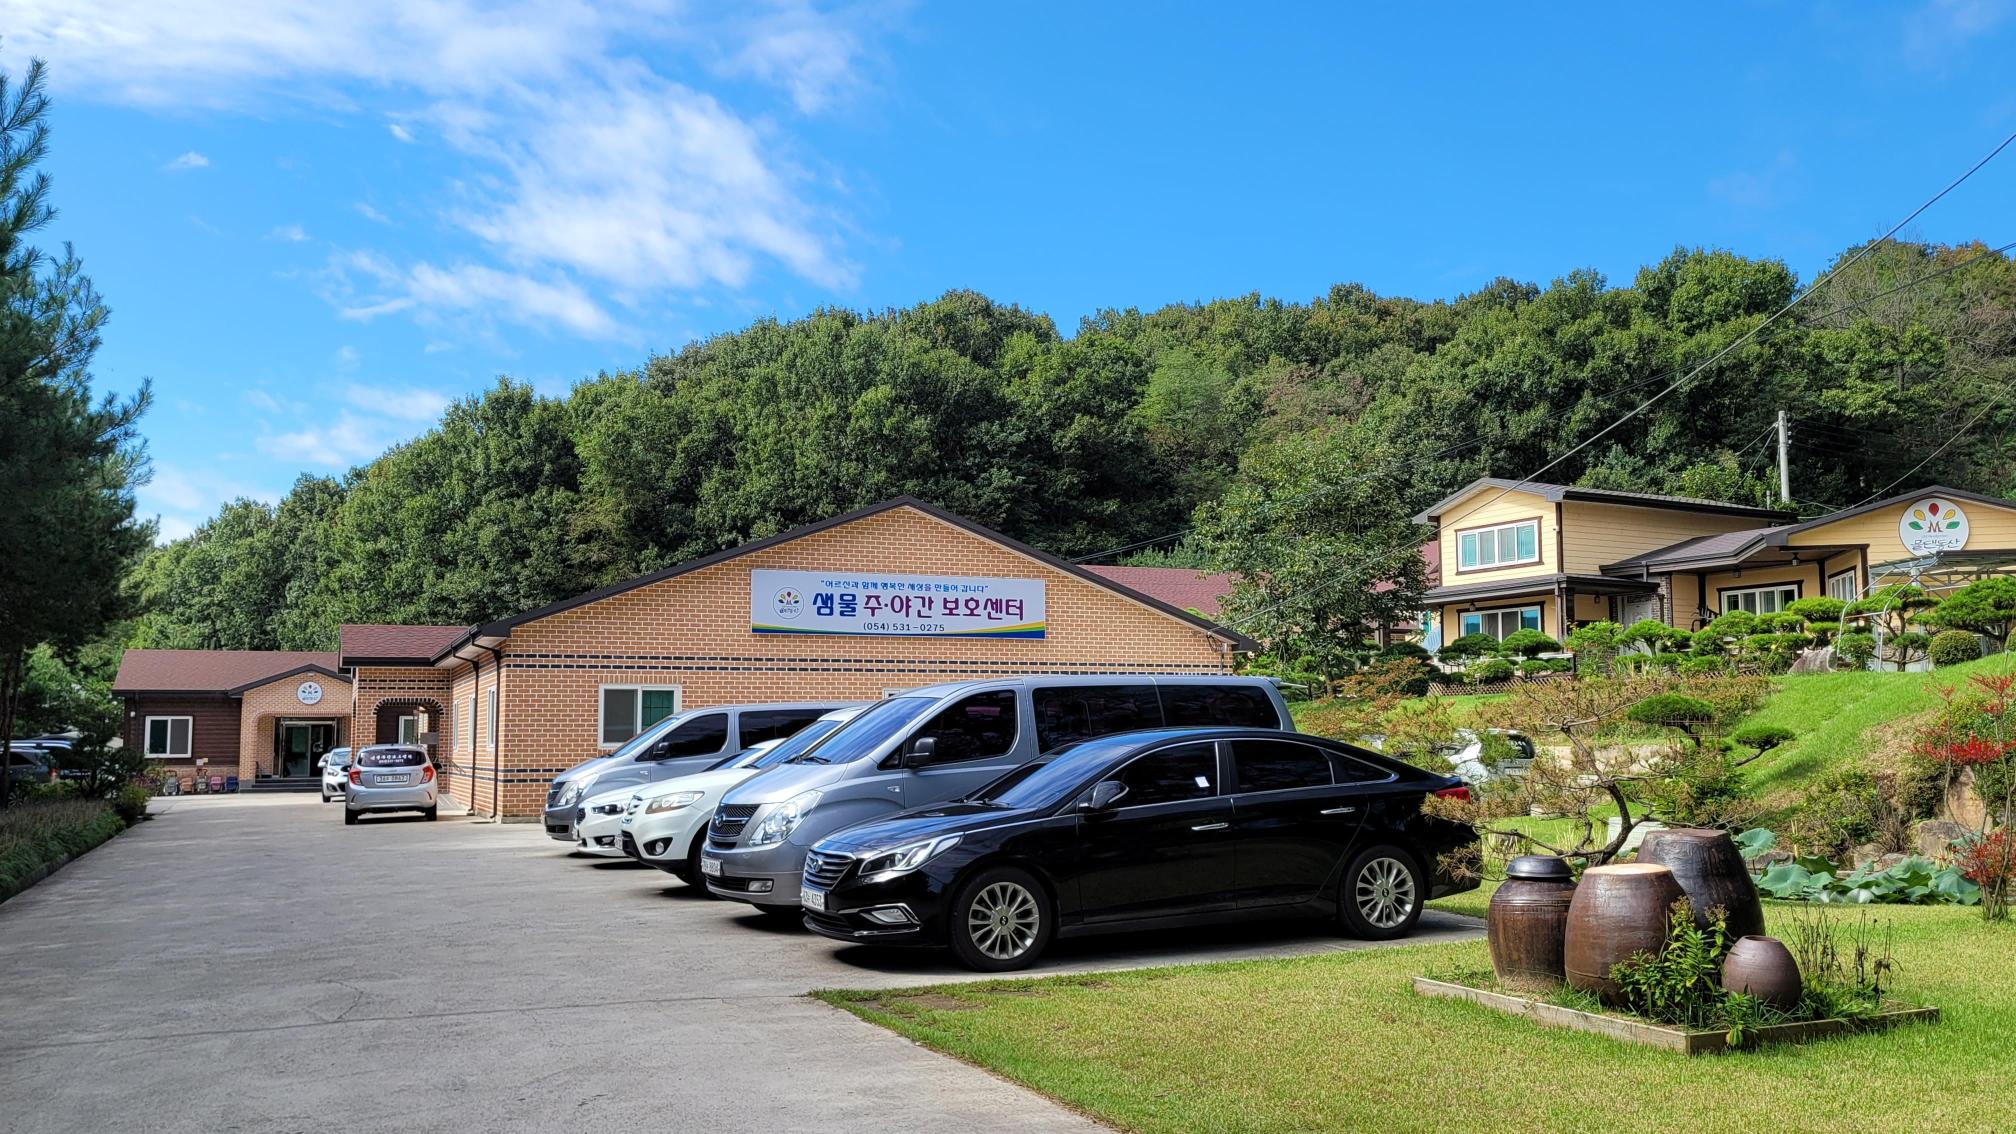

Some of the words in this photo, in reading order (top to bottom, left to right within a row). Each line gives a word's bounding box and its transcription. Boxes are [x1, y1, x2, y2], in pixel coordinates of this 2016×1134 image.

[862, 581, 878, 590] 함께
[881, 581, 905, 591] 행복한
[908, 582, 932, 592] 세상을
[934, 583, 958, 592] 만들어
[812, 592, 858, 617] 샘물
[941, 596, 1024, 621] 보호센터
[863, 622, 890, 631] (054)
[892, 623, 945, 632] 531-0275
